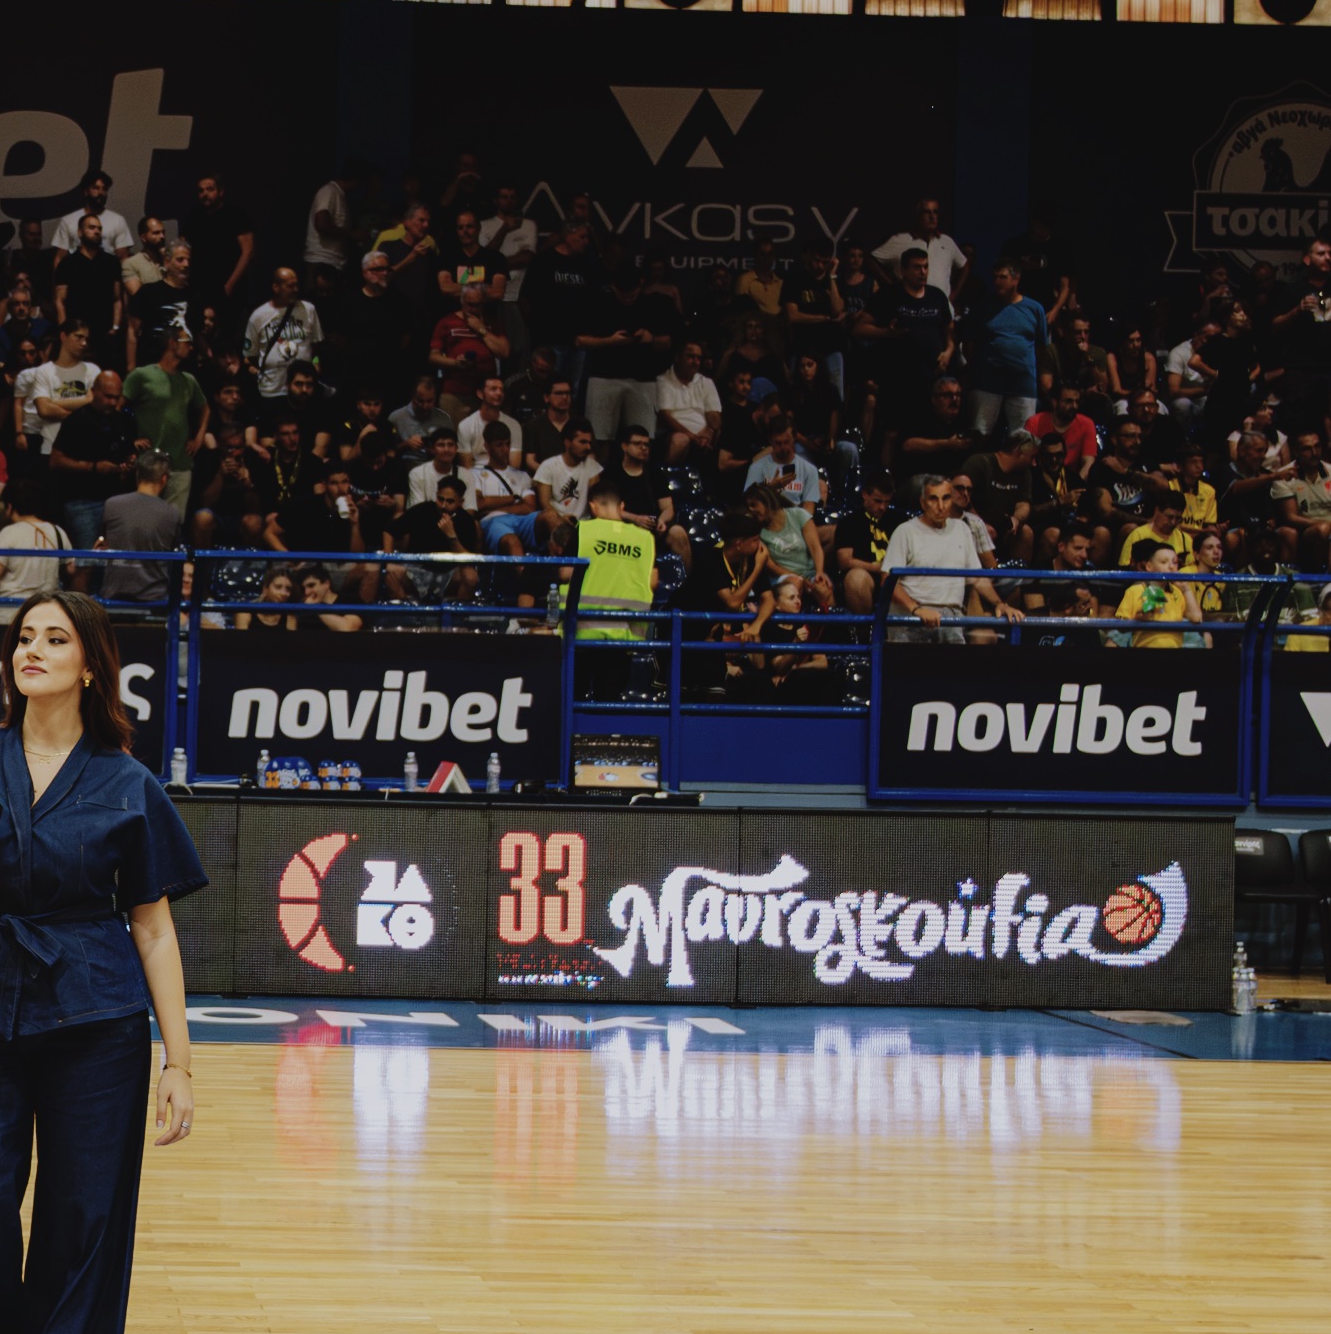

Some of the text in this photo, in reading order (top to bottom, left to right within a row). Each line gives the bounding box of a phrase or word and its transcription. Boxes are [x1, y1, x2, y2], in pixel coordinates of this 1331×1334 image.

[605, 541, 642, 558] BMS
[228, 670, 533, 744] novibet
[907, 683, 1207, 756] novibet
[498, 832, 588, 946] 33
